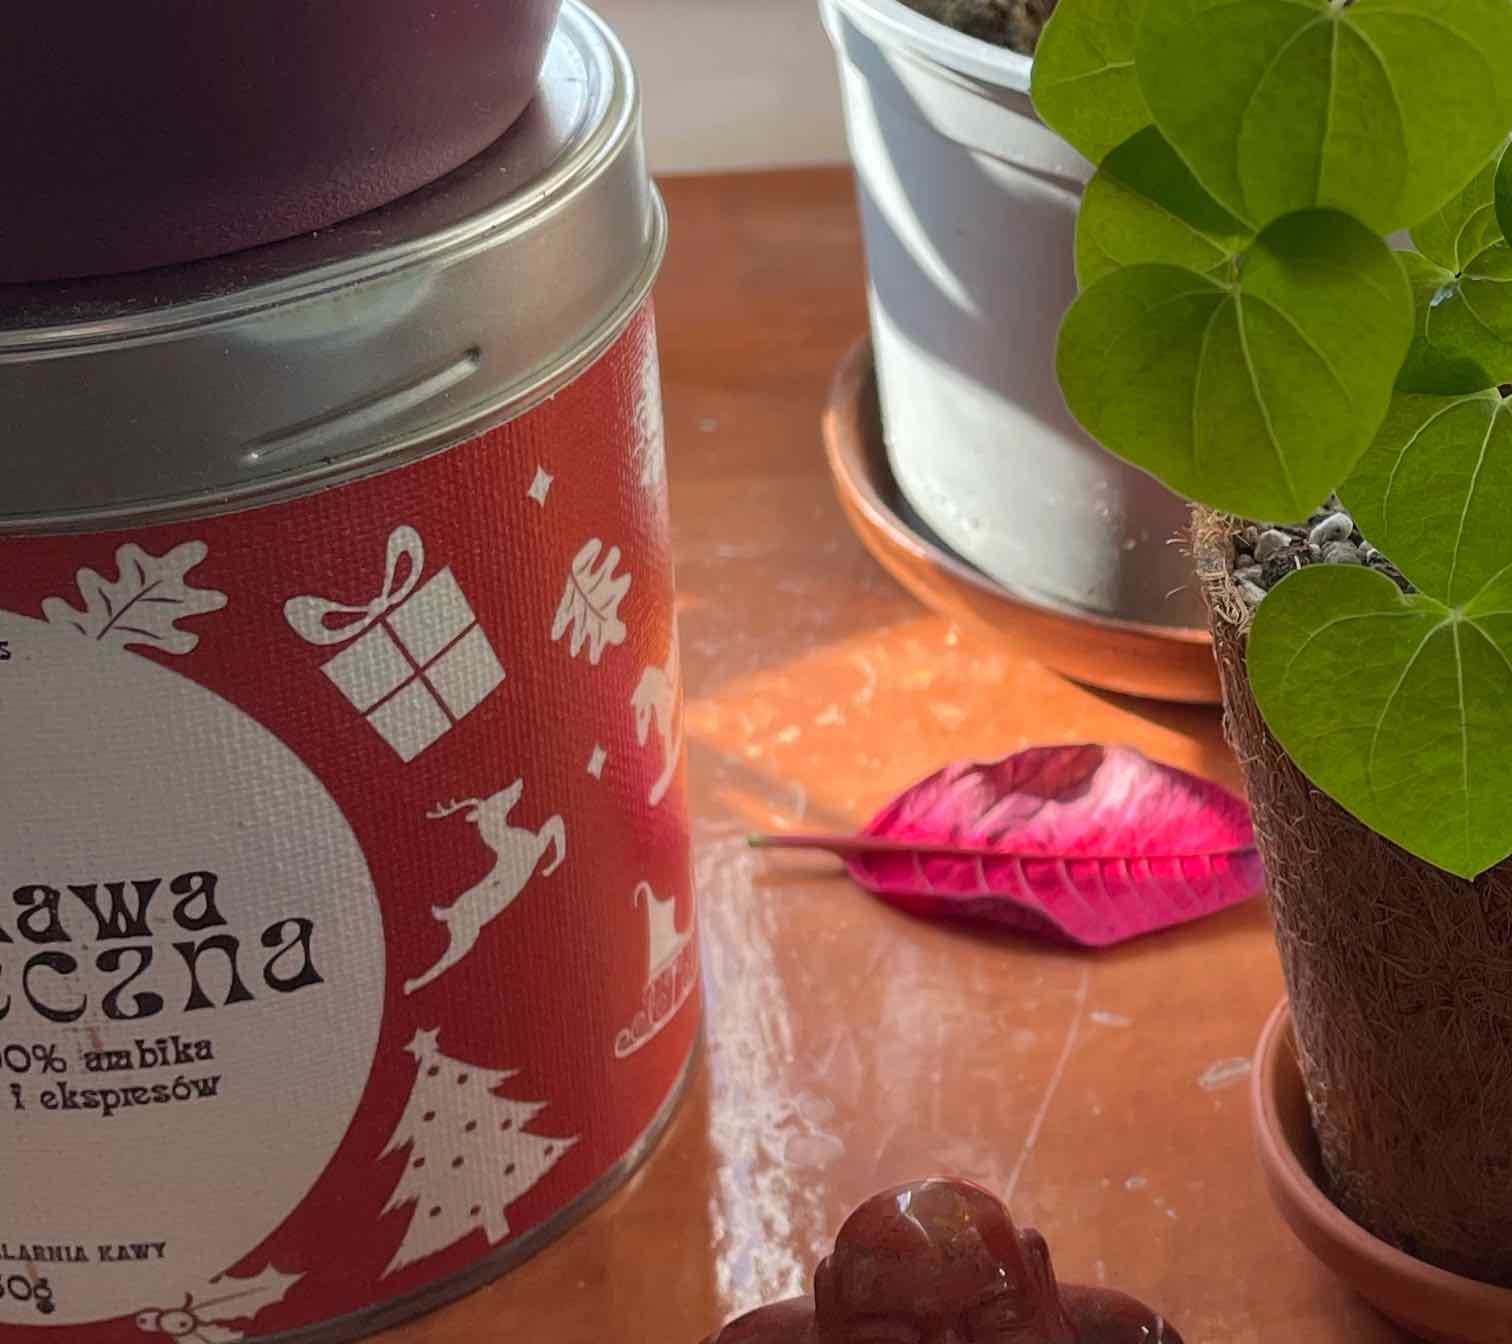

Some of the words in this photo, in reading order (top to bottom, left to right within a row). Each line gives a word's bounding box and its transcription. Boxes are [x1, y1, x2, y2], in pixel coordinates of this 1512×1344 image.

[0, 871, 227, 944] awa
[0, 918, 325, 1023] czna
[0, 1043, 67, 1074] 0%
[10, 1082, 25, 1110] i
[40, 1075, 222, 1117] ekspresów
[0, 1243, 89, 1262] LARNIA
[98, 1242, 167, 1261] KAWY
